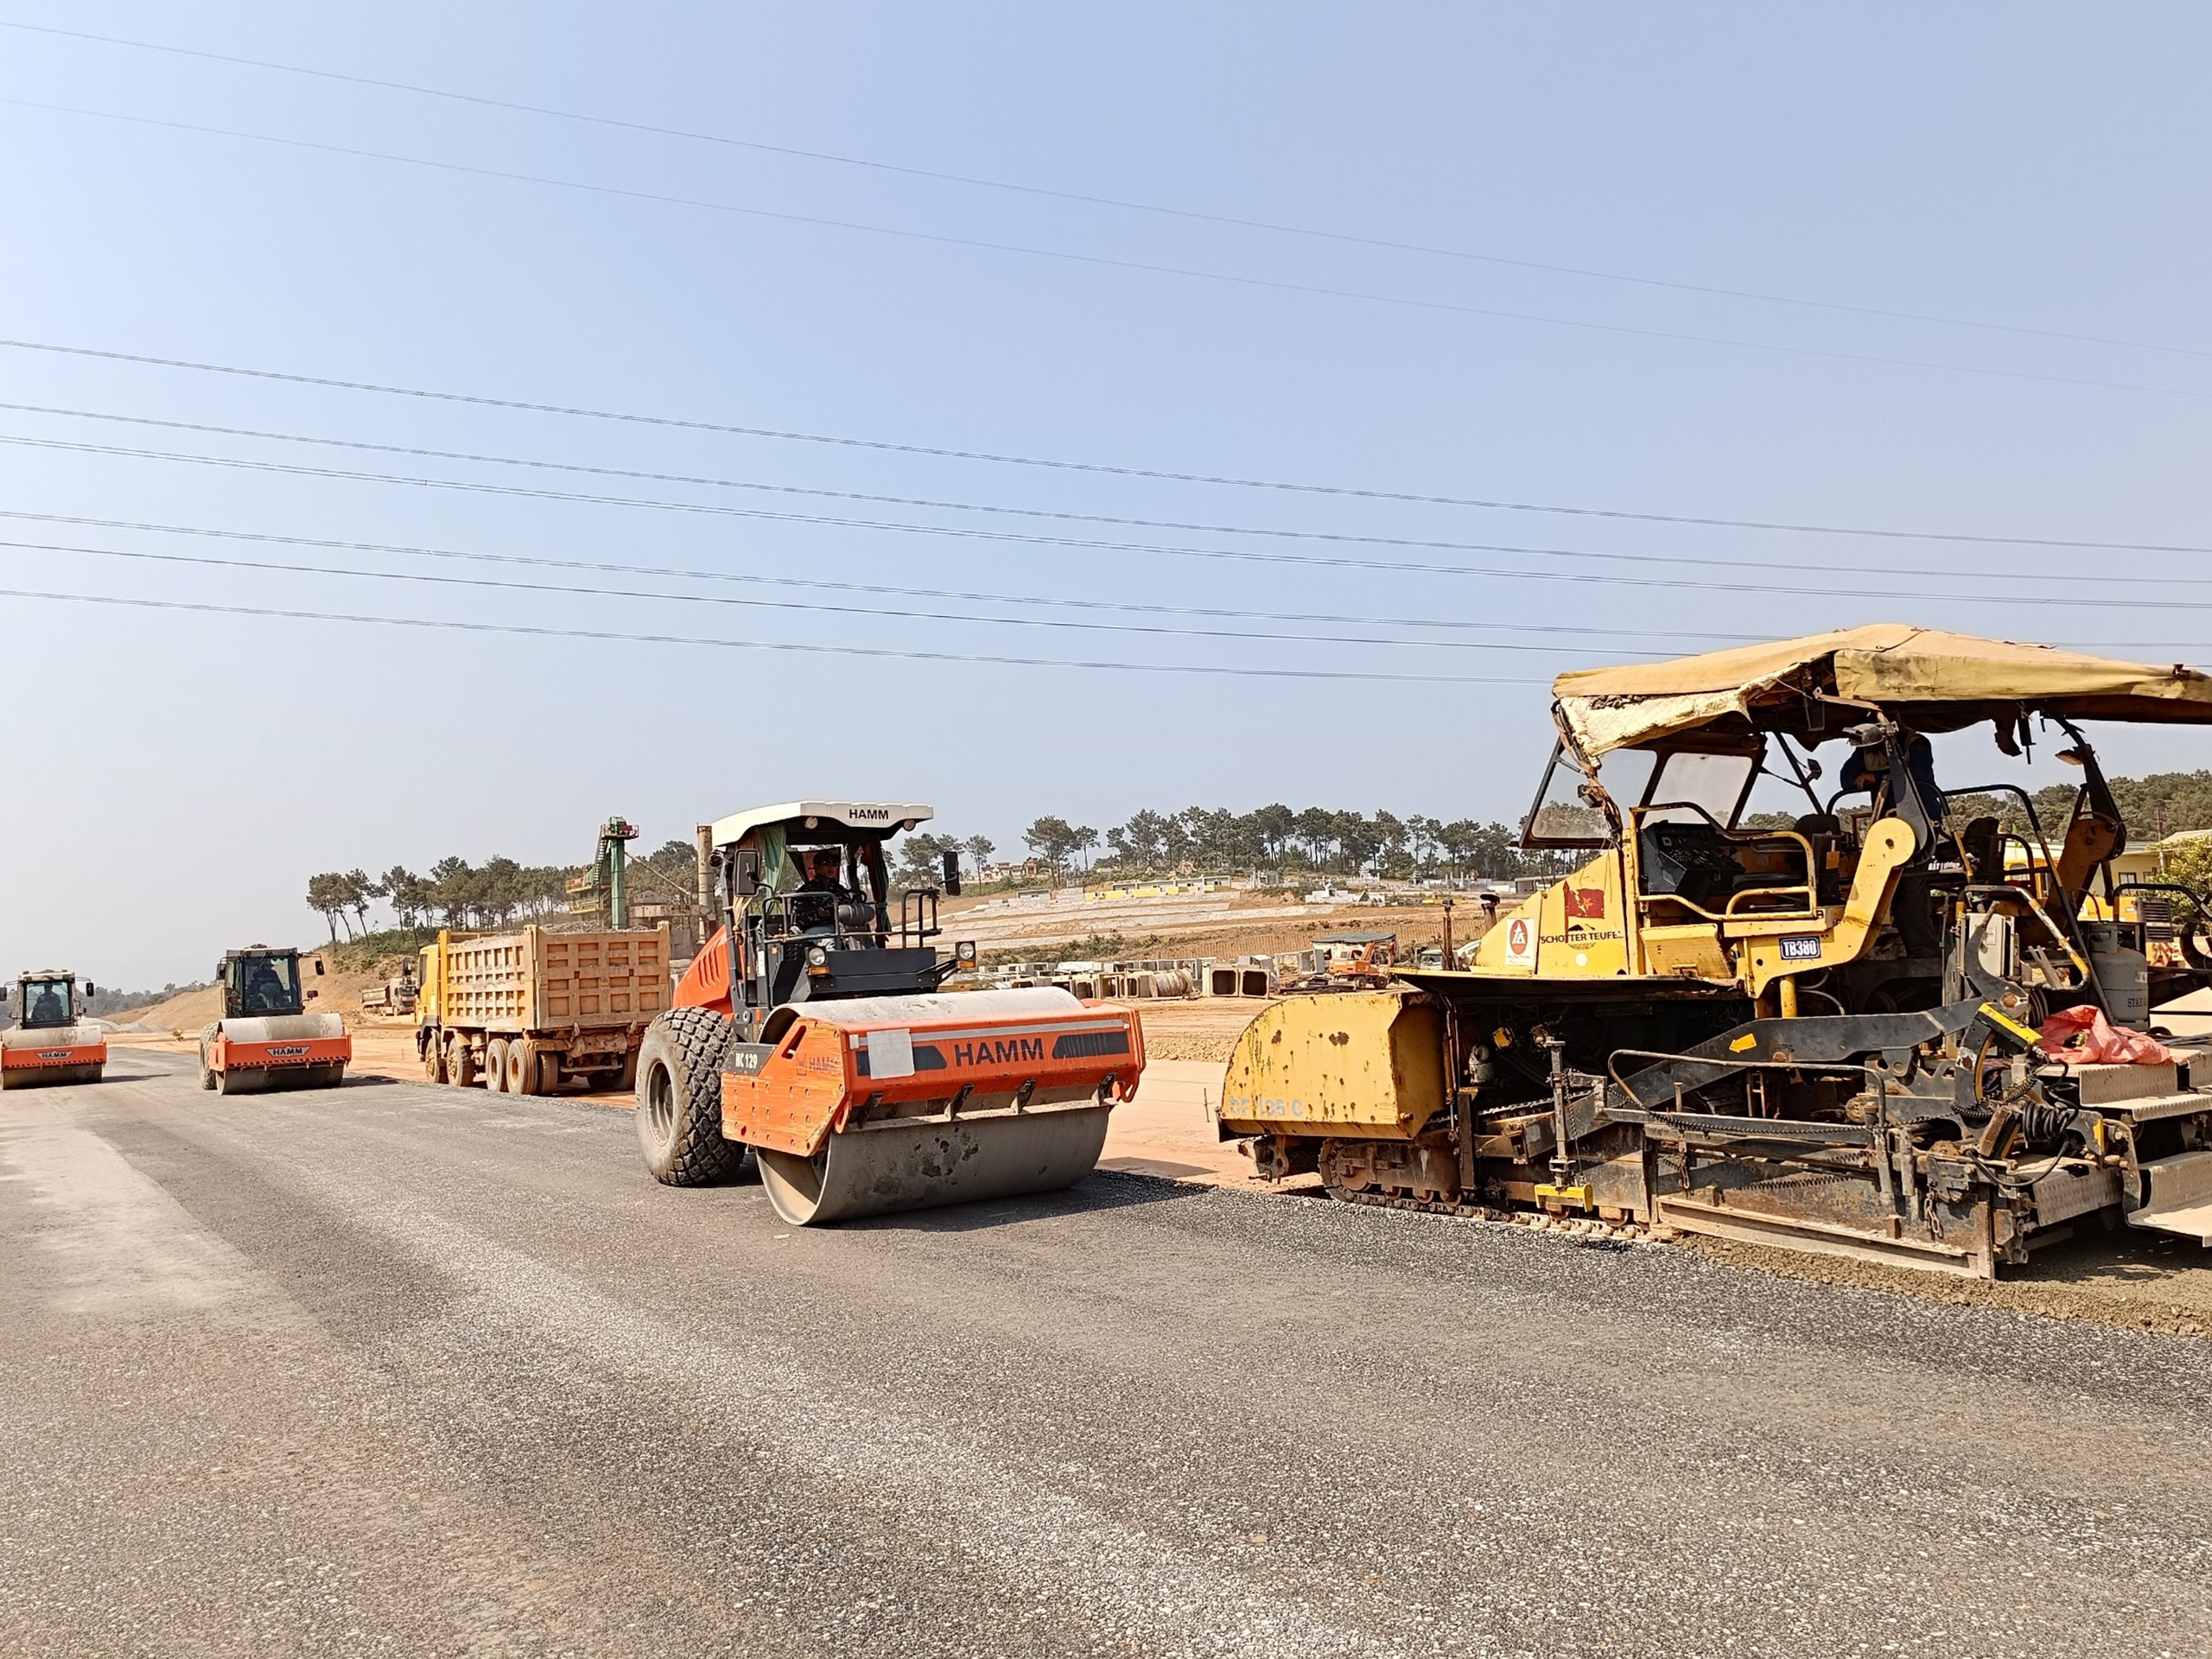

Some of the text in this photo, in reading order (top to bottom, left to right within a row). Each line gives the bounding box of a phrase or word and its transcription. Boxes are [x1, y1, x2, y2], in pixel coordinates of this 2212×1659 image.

[849, 809, 888, 820] HAMM
[1540, 933, 1587, 944] SCHOTTER
[1783, 940, 1817, 957] TB380
[273, 1047, 303, 1056] HAMM
[954, 1038, 1044, 1066] HAMM
[745, 1052, 758, 1070] 129
[1291, 1099, 1304, 1117] C
